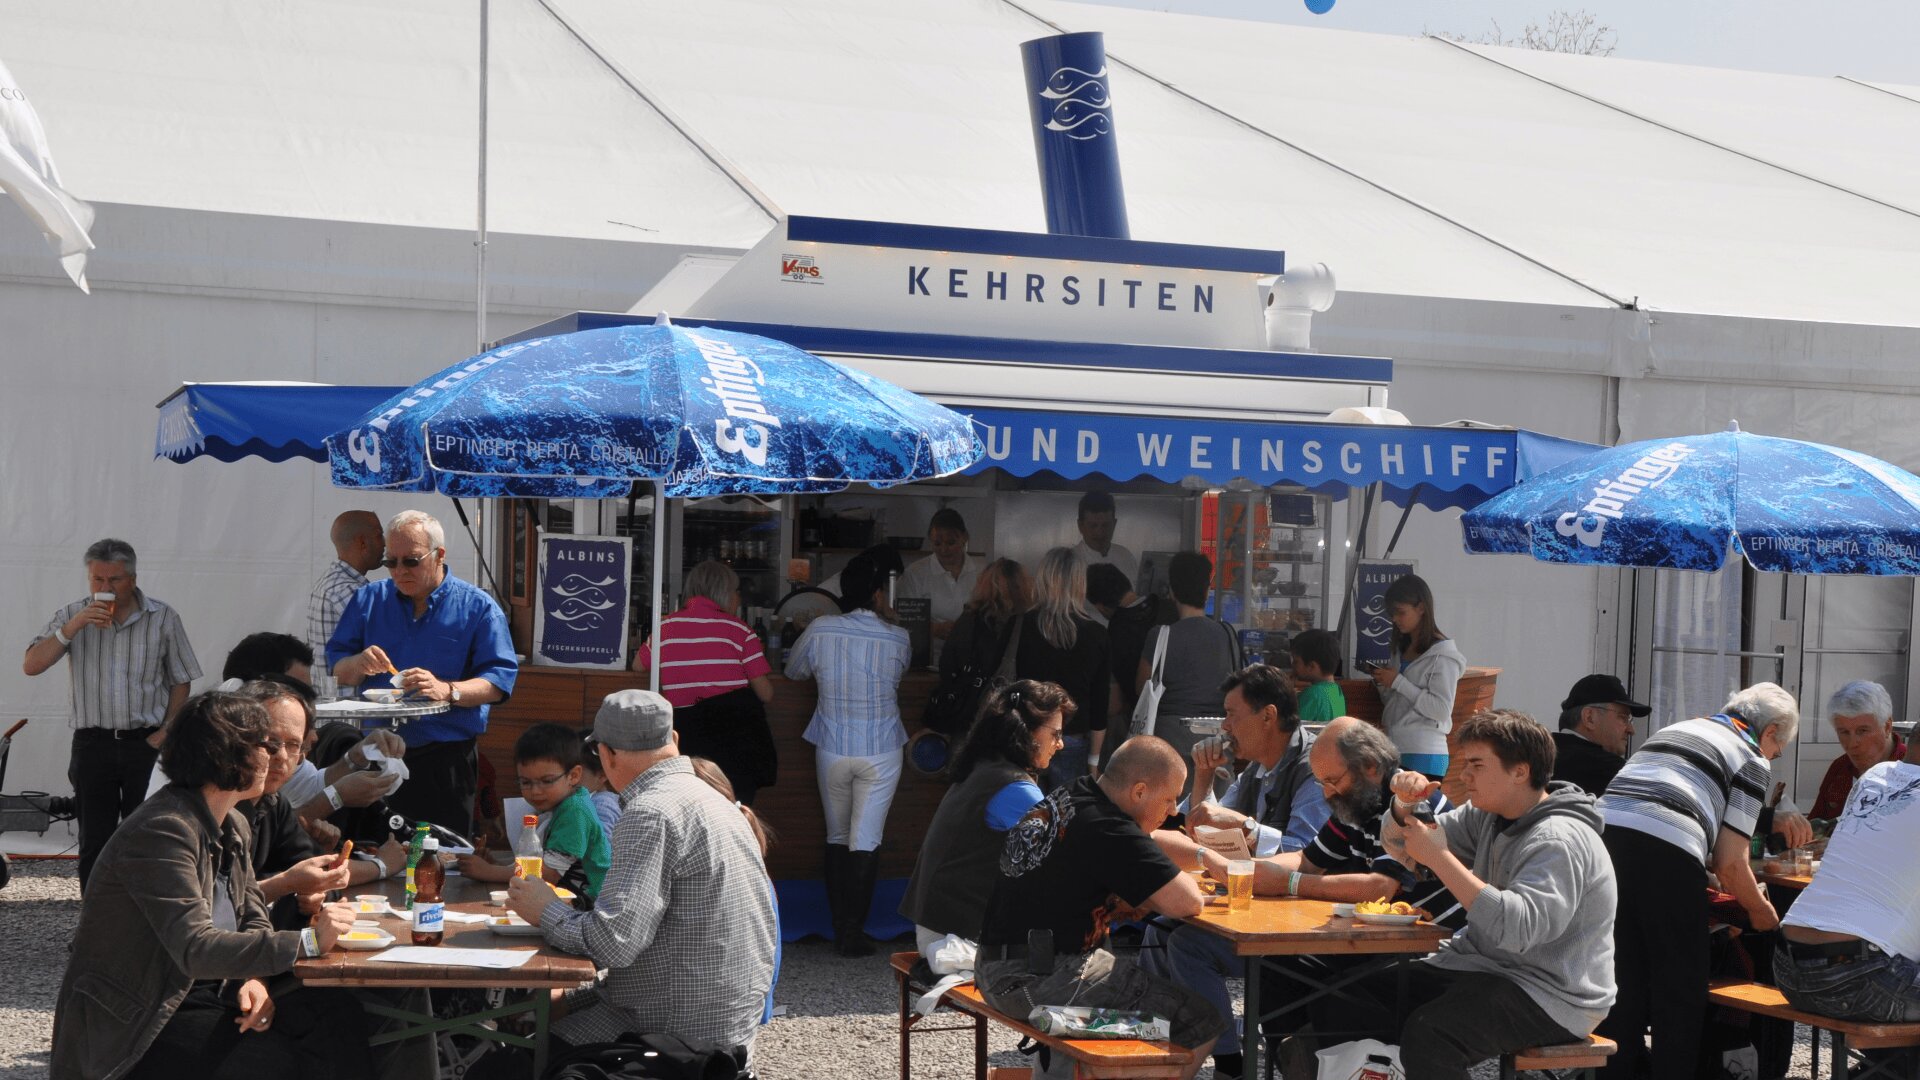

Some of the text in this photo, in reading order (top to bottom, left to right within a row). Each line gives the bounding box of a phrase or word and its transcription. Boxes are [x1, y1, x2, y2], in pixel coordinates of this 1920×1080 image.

[908, 265, 1214, 314] KEHRSITEN
[684, 332, 783, 467] Eptinger
[435, 434, 671, 467] EPTINGER PEPITA CRISTALLO
[987, 426, 1100, 464] UND
[1136, 432, 1507, 478] WEINSCHIFF
[1555, 442, 1697, 548] Eptinger
[557, 550, 615, 563] ALBINS
[1751, 536, 1810, 553] EPTINGER
[1816, 539, 1860, 555] PEPITA
[1365, 573, 1406, 584] ALBIN
